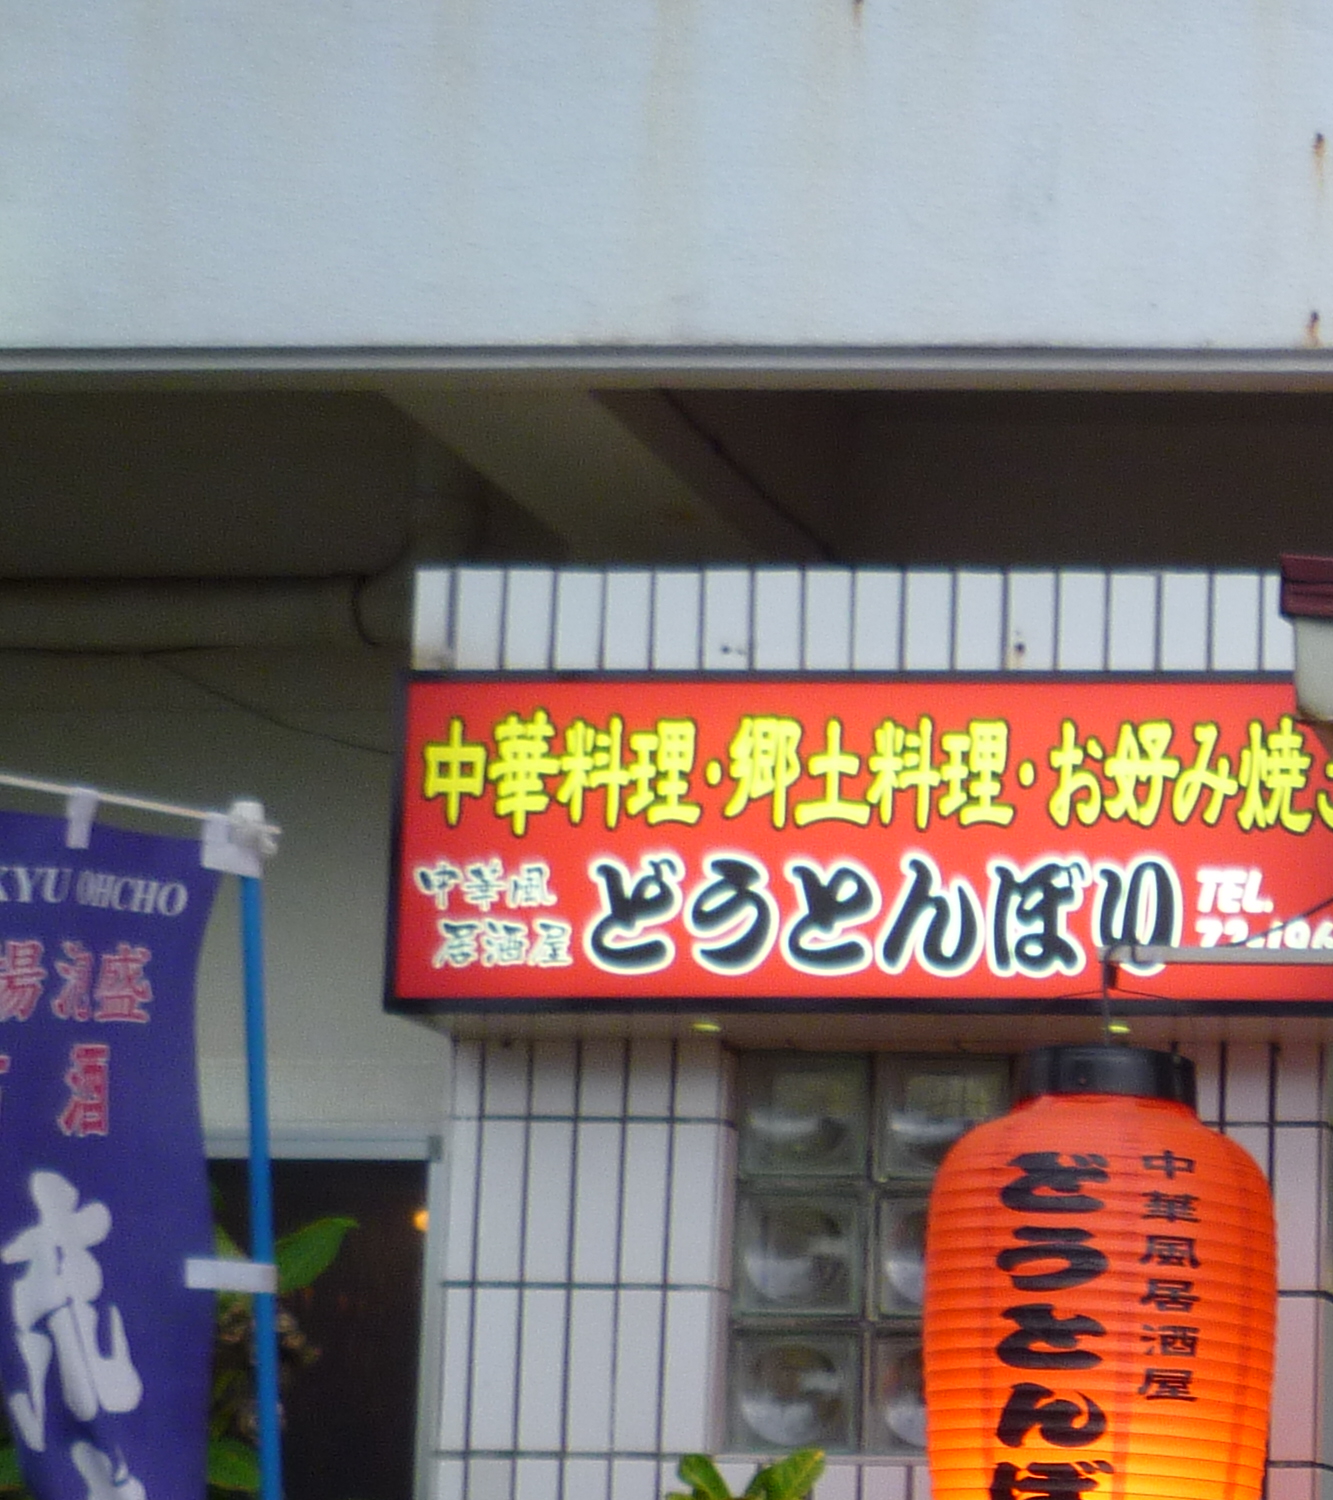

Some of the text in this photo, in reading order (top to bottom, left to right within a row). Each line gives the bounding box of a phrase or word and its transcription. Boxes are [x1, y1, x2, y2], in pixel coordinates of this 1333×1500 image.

[0, 865, 73, 904] YU
[414, 859, 557, 911] 中華風
[584, 853, 1183, 977] どうとんぼり
[432, 917, 573, 968] 居酒屋
[1137, 1149, 1201, 1402] 中華風居酒屋
